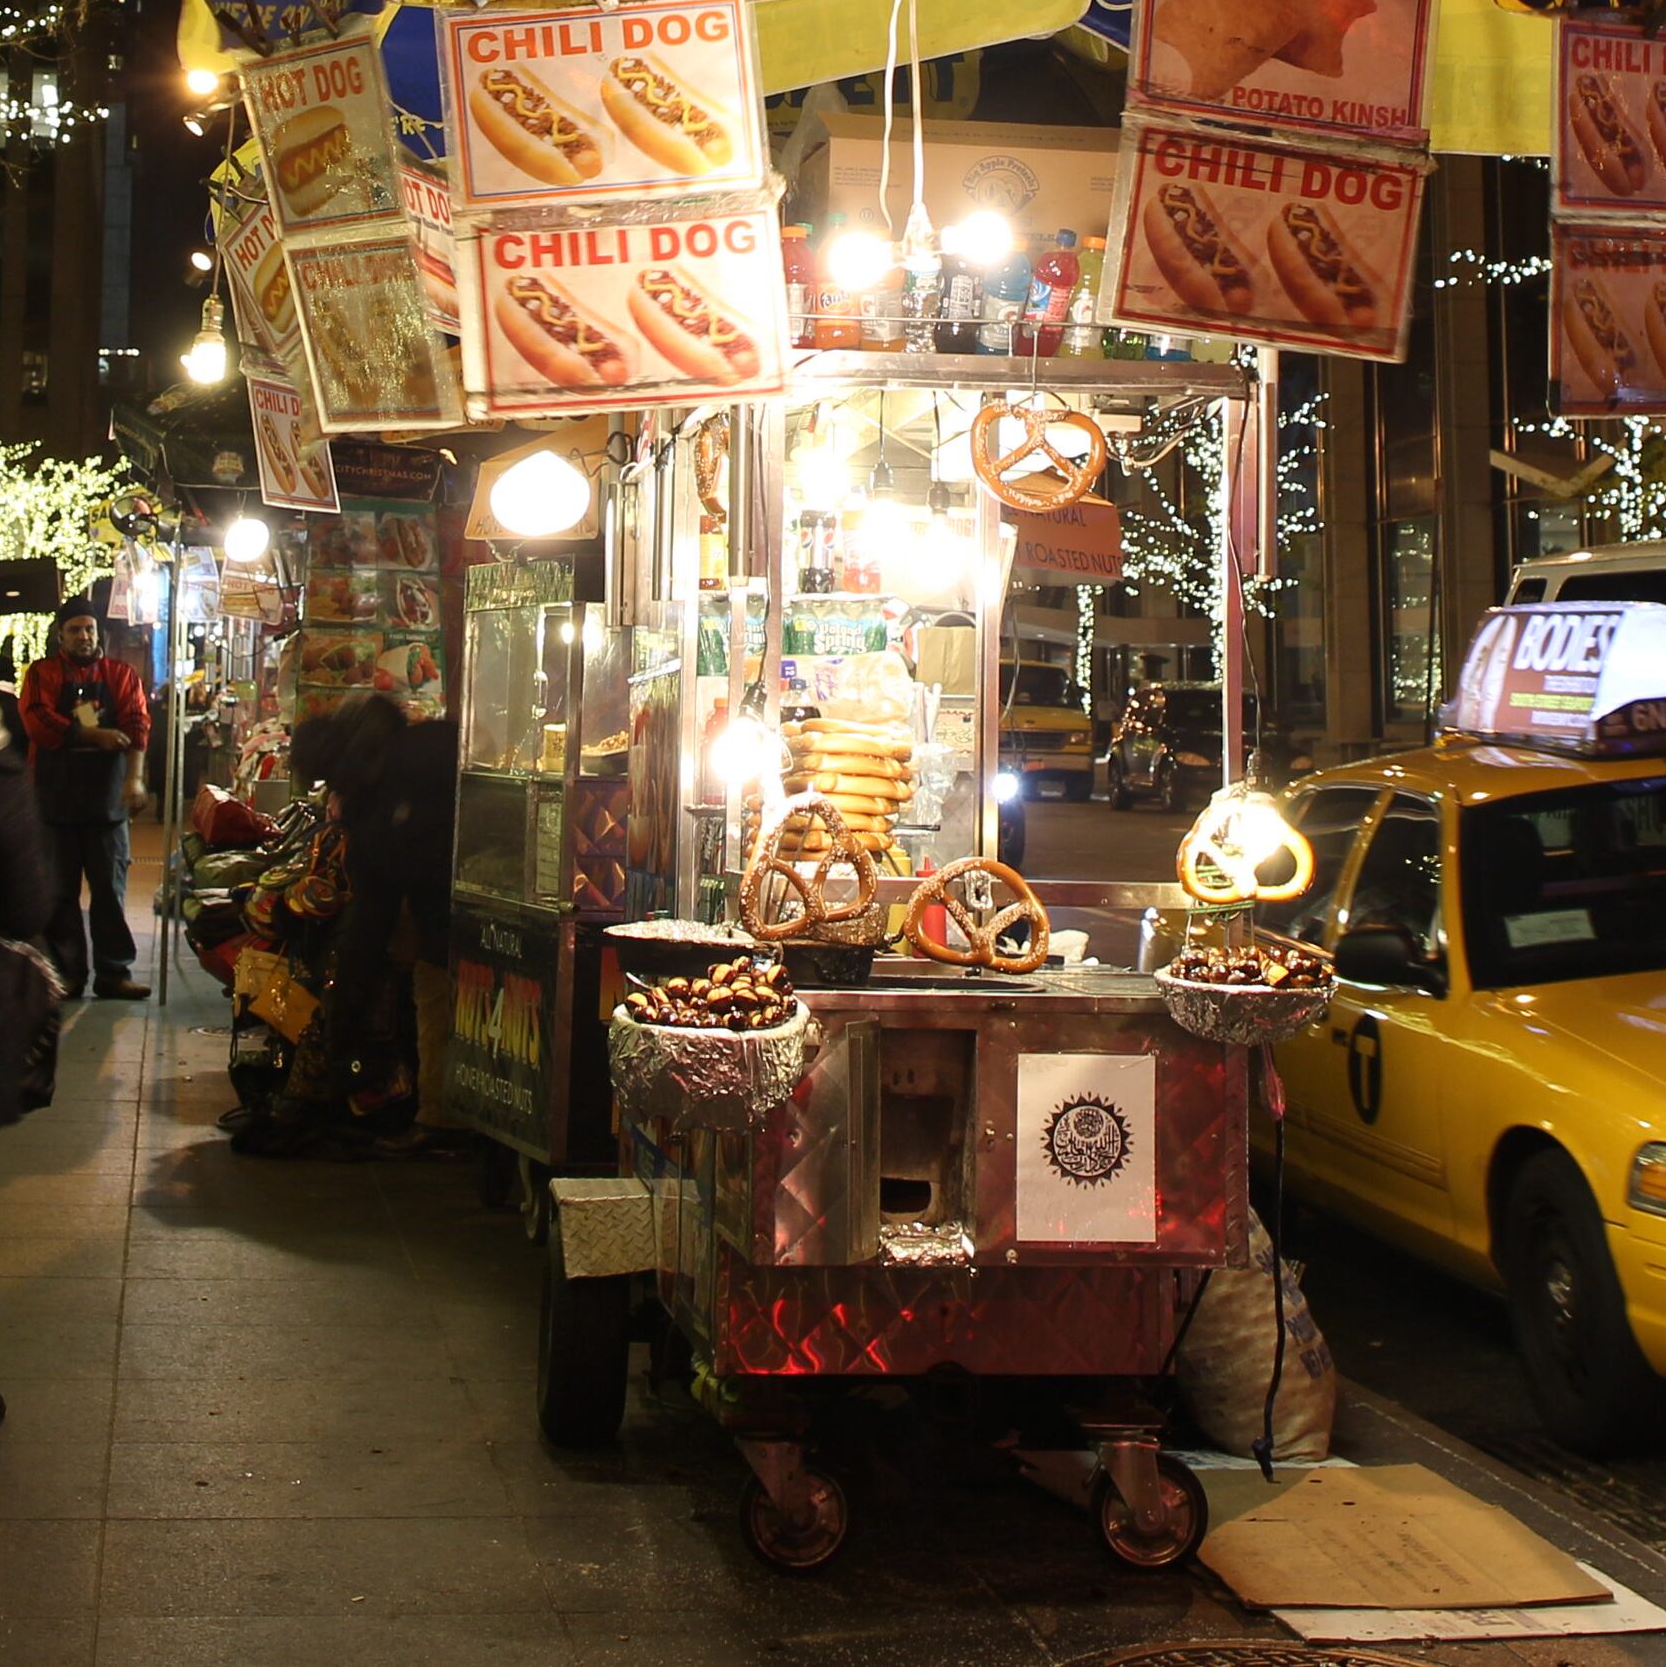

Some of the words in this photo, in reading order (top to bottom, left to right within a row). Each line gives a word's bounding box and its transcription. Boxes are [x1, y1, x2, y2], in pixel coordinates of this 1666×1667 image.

[466, 19, 602, 63] CHILI
[622, 6, 731, 49] DOG
[1572, 37, 1651, 77] CHILI
[260, 70, 309, 113] HOT
[313, 56, 366, 103] DOG
[1232, 84, 1324, 119] POTATO
[1153, 137, 1282, 193] CHILI
[1299, 161, 1404, 211] DOG
[402, 176, 426, 215] OT
[426, 186, 452, 226] DO
[235, 229, 264, 272] HOT
[493, 226, 631, 270] CHILI
[648, 220, 758, 263] DOG
[255, 388, 289, 415] CHILI
[1025, 541, 1090, 569] ROASTED
